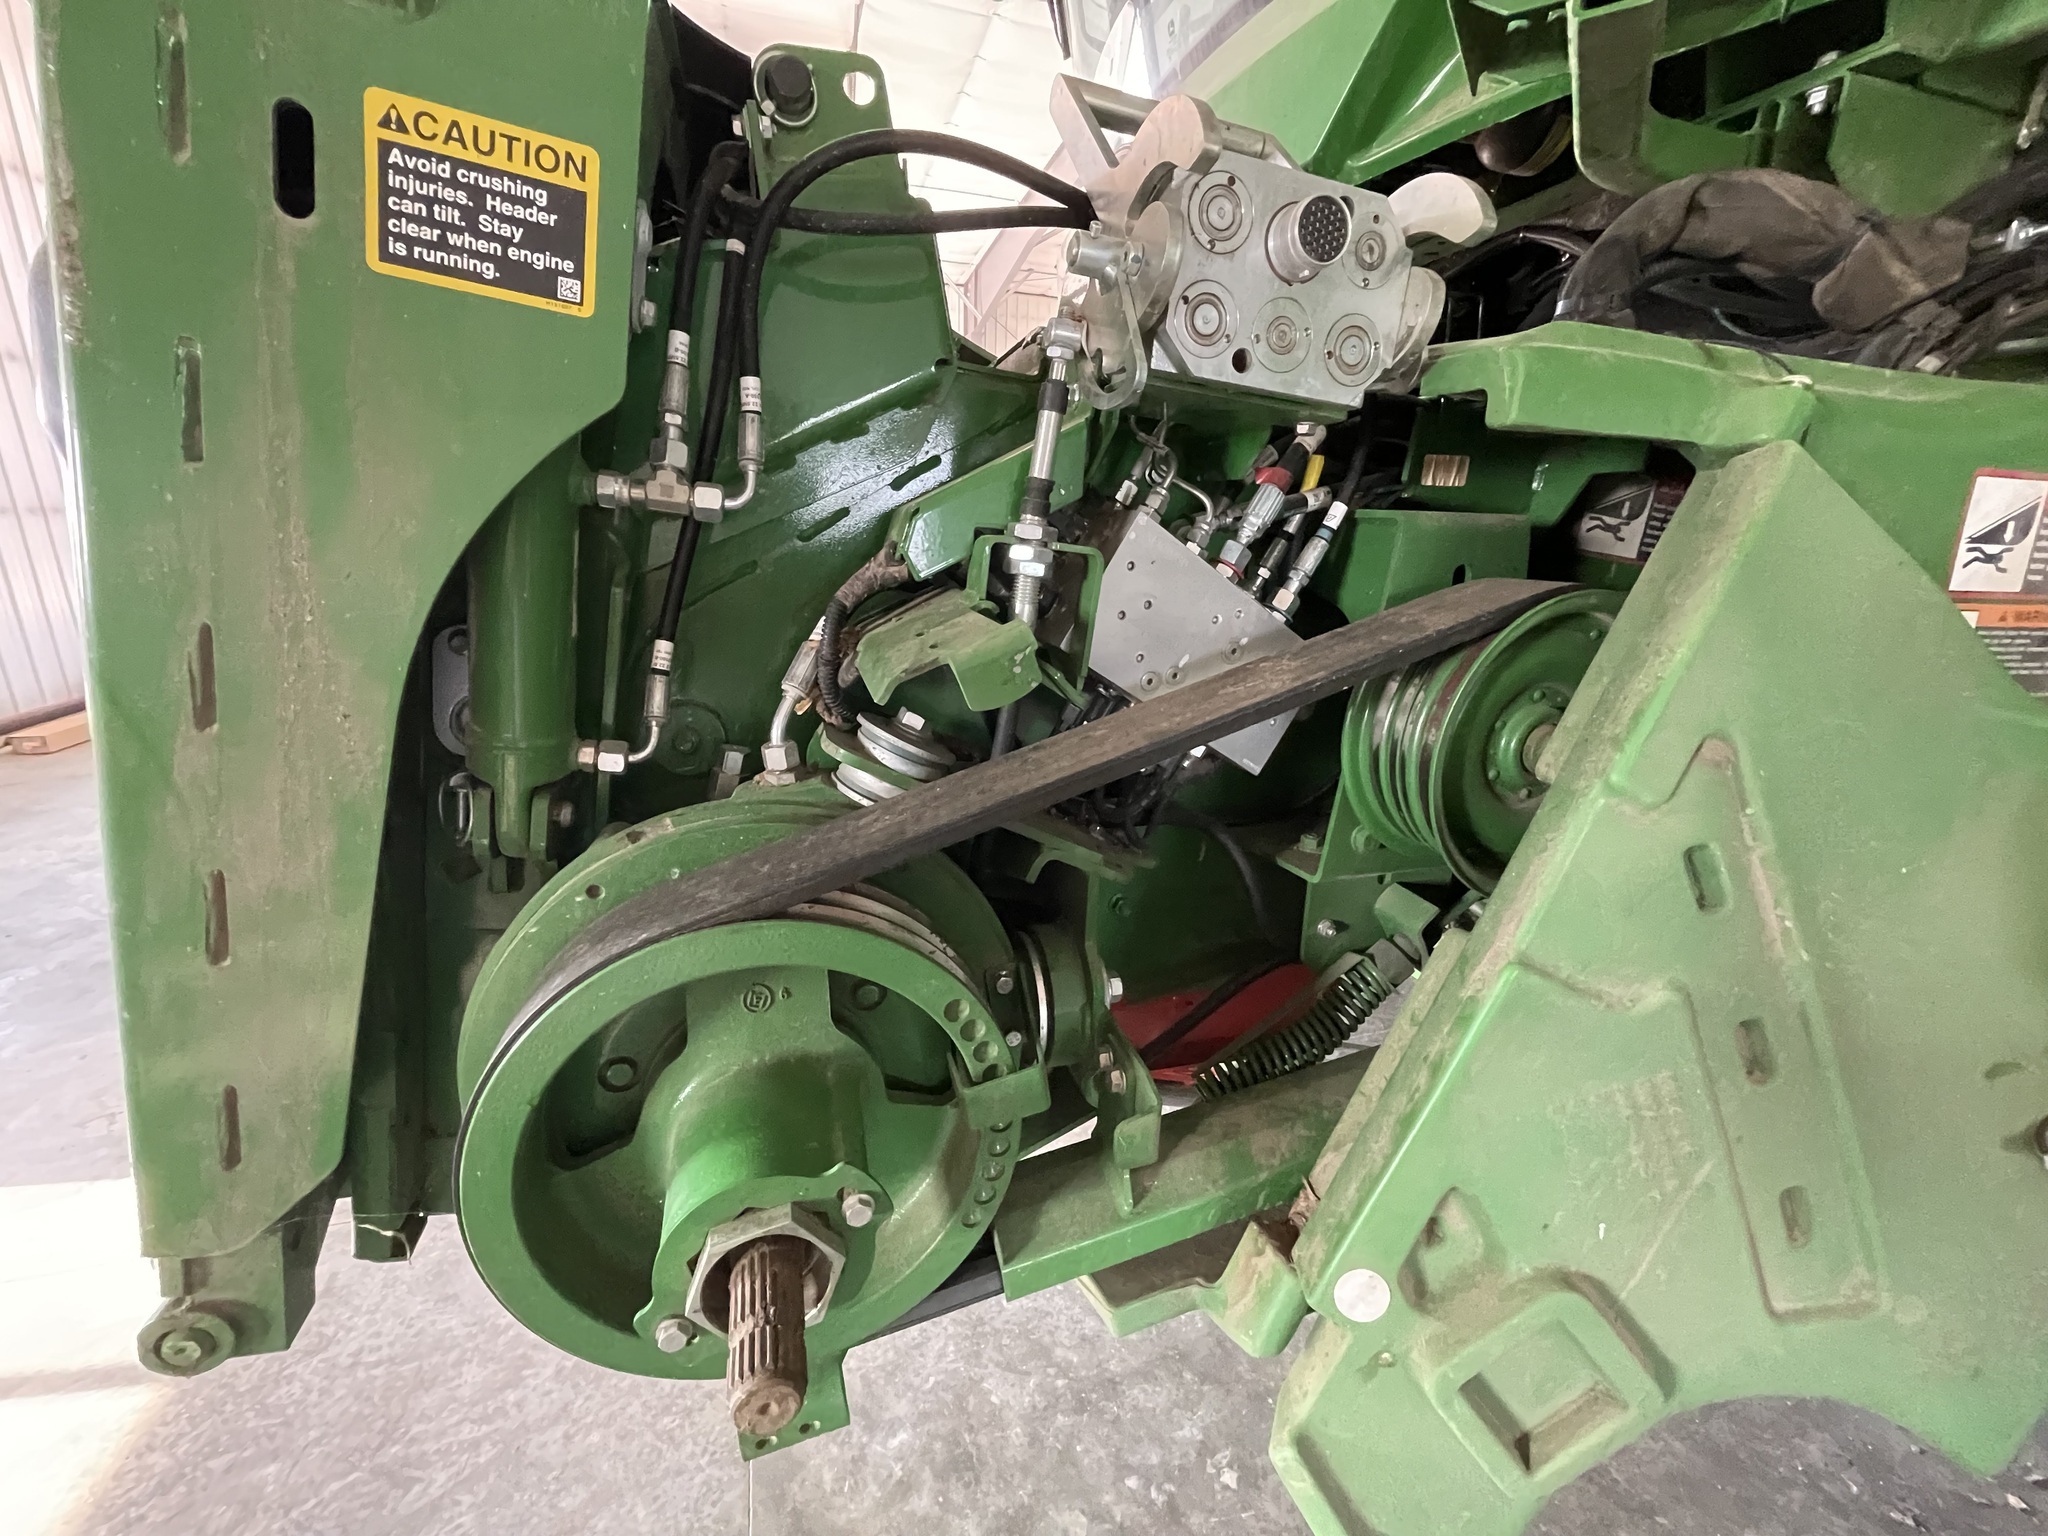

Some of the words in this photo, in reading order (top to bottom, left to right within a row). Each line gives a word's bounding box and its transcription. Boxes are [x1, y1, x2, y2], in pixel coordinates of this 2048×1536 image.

[413, 111, 586, 182] CAUTION
[387, 148, 450, 179] Avoid
[456, 168, 547, 205] crushing
[387, 169, 473, 206] injuries.
[485, 194, 558, 227] Header
[387, 197, 427, 217] can
[433, 204, 466, 226] tilt.
[478, 215, 523, 243] Stay
[387, 218, 441, 242] clear
[446, 231, 502, 257] when
[507, 247, 575, 273] engine
[387, 237, 407, 256] is
[413, 246, 500, 280] running.
